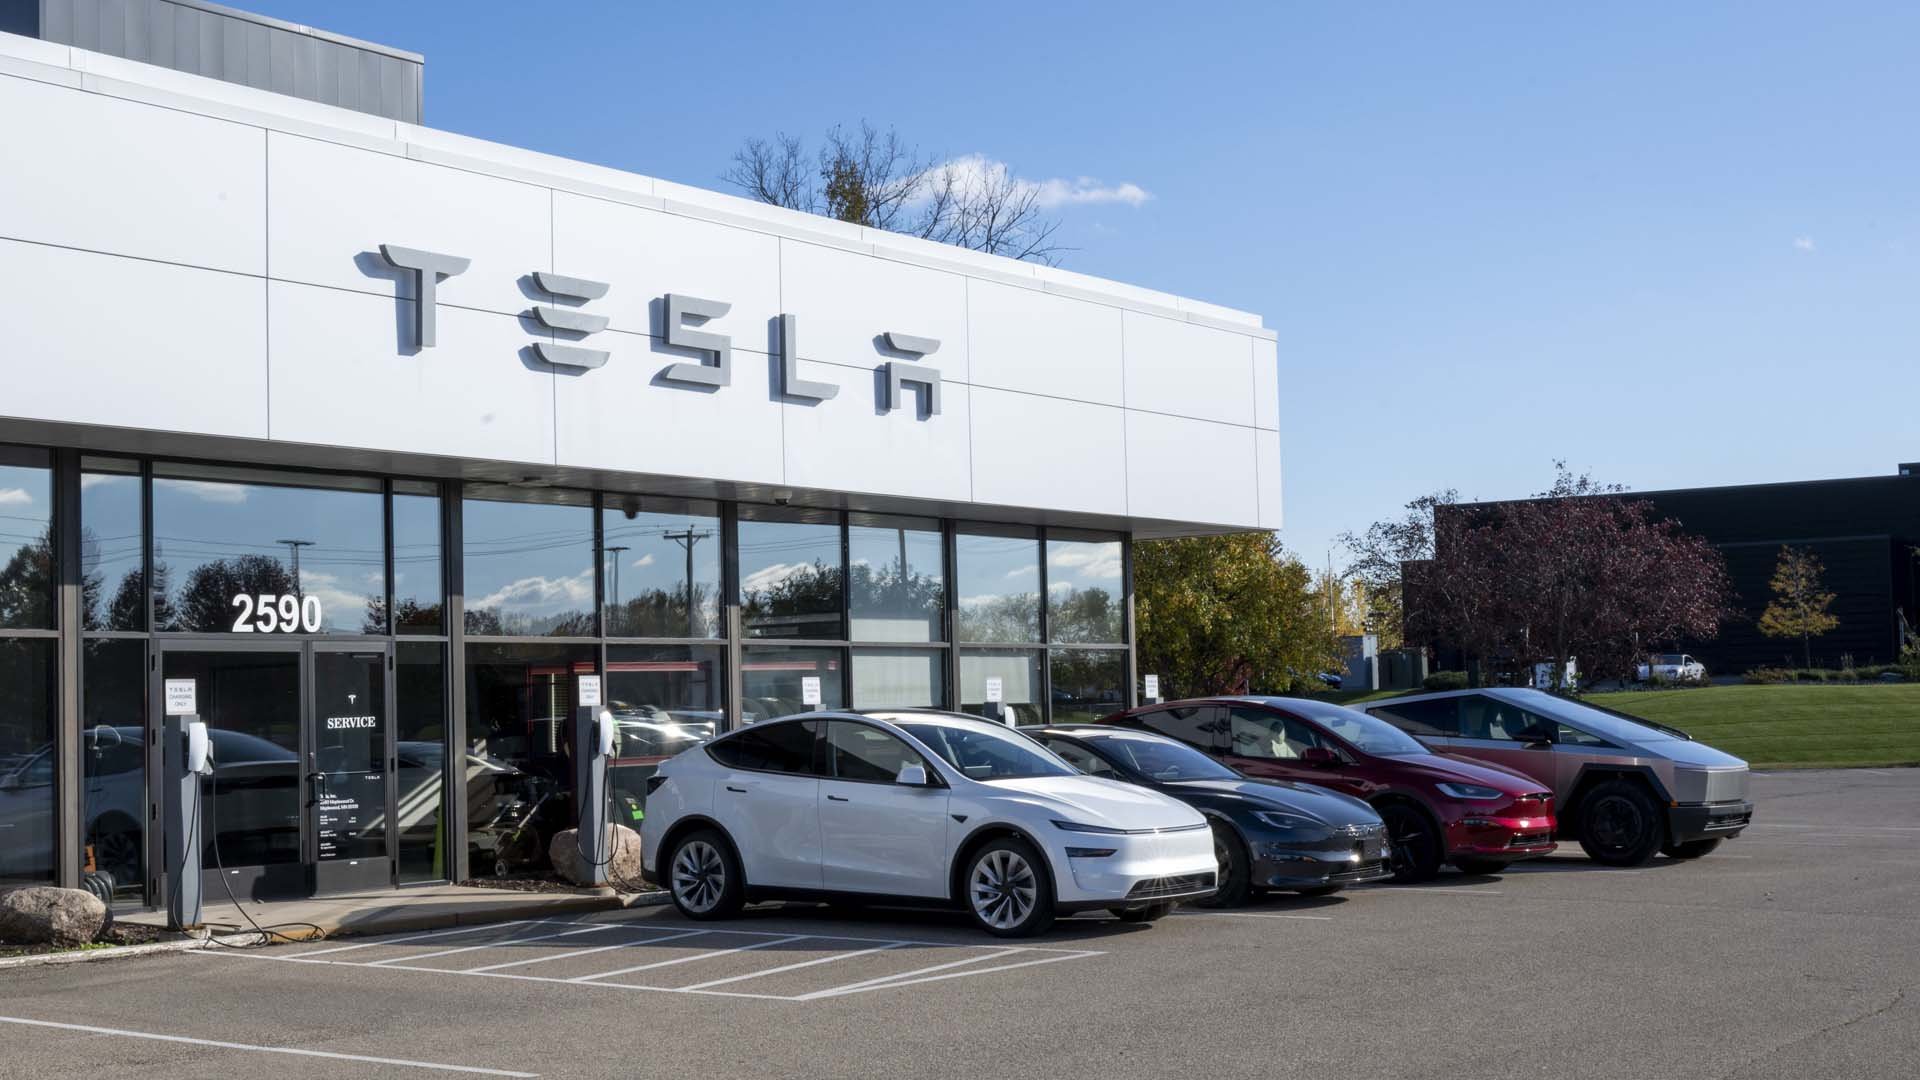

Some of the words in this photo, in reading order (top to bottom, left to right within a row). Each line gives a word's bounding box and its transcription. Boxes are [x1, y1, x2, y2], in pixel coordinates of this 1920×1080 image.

[378, 243, 942, 415] TESLA
[232, 593, 322, 633] 2590
[327, 716, 376, 729] SERVICE
